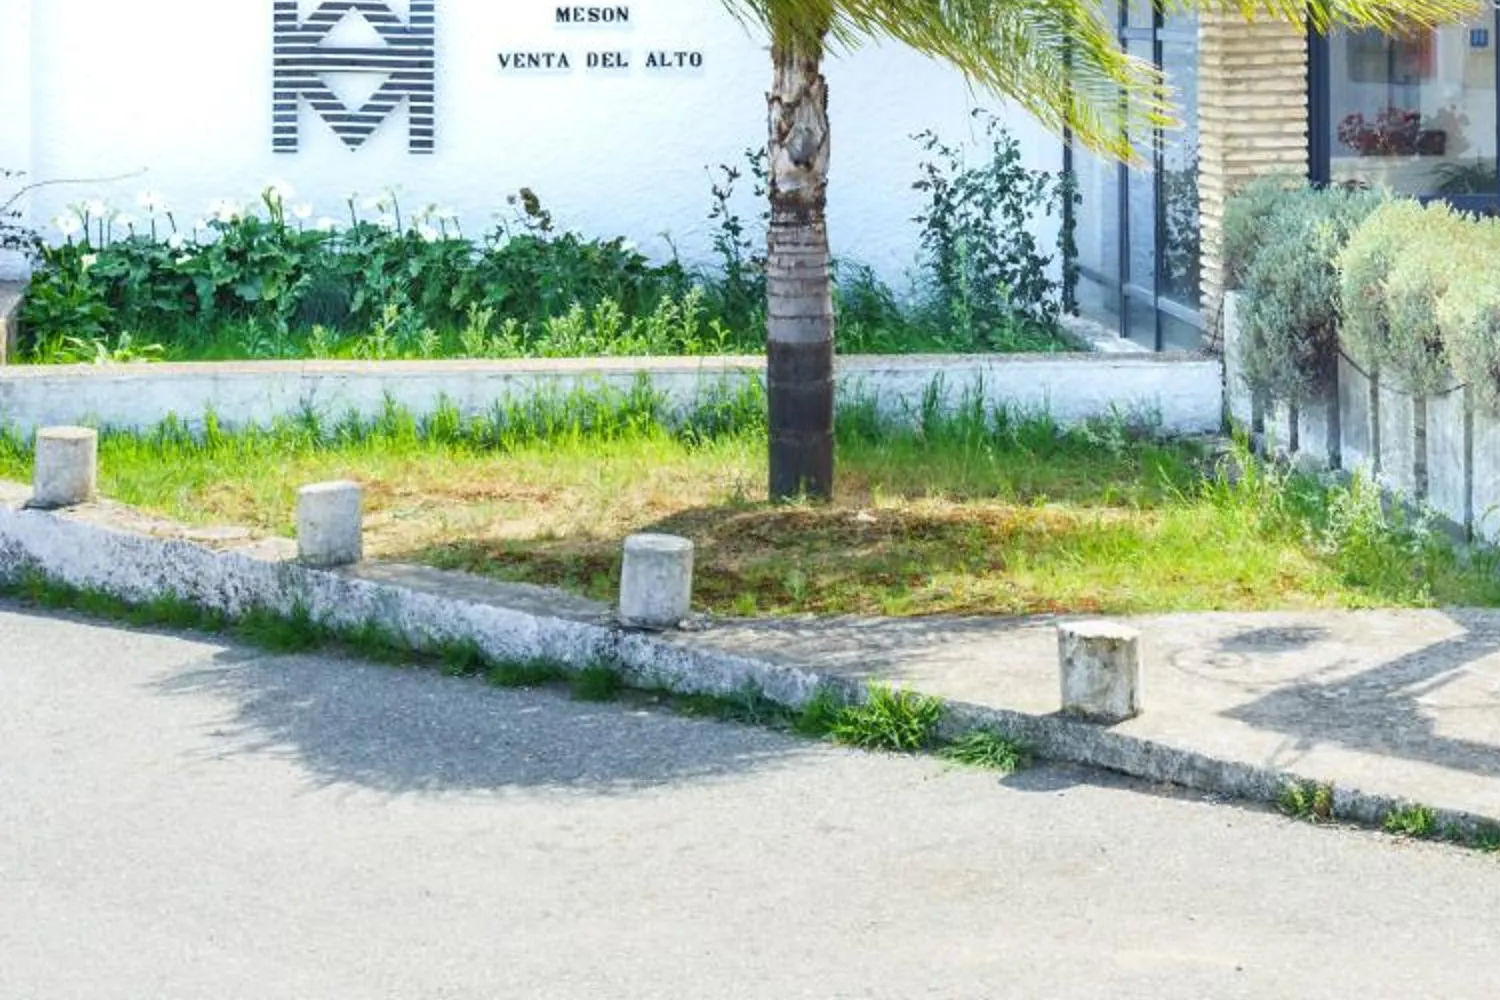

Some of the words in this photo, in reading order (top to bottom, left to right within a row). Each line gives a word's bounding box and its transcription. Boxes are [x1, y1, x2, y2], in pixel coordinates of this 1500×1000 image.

[555, 6, 629, 22] MESON
[497, 52, 570, 69] VENTA
[586, 51, 629, 68] DEL
[645, 51, 703, 68] ALTO
